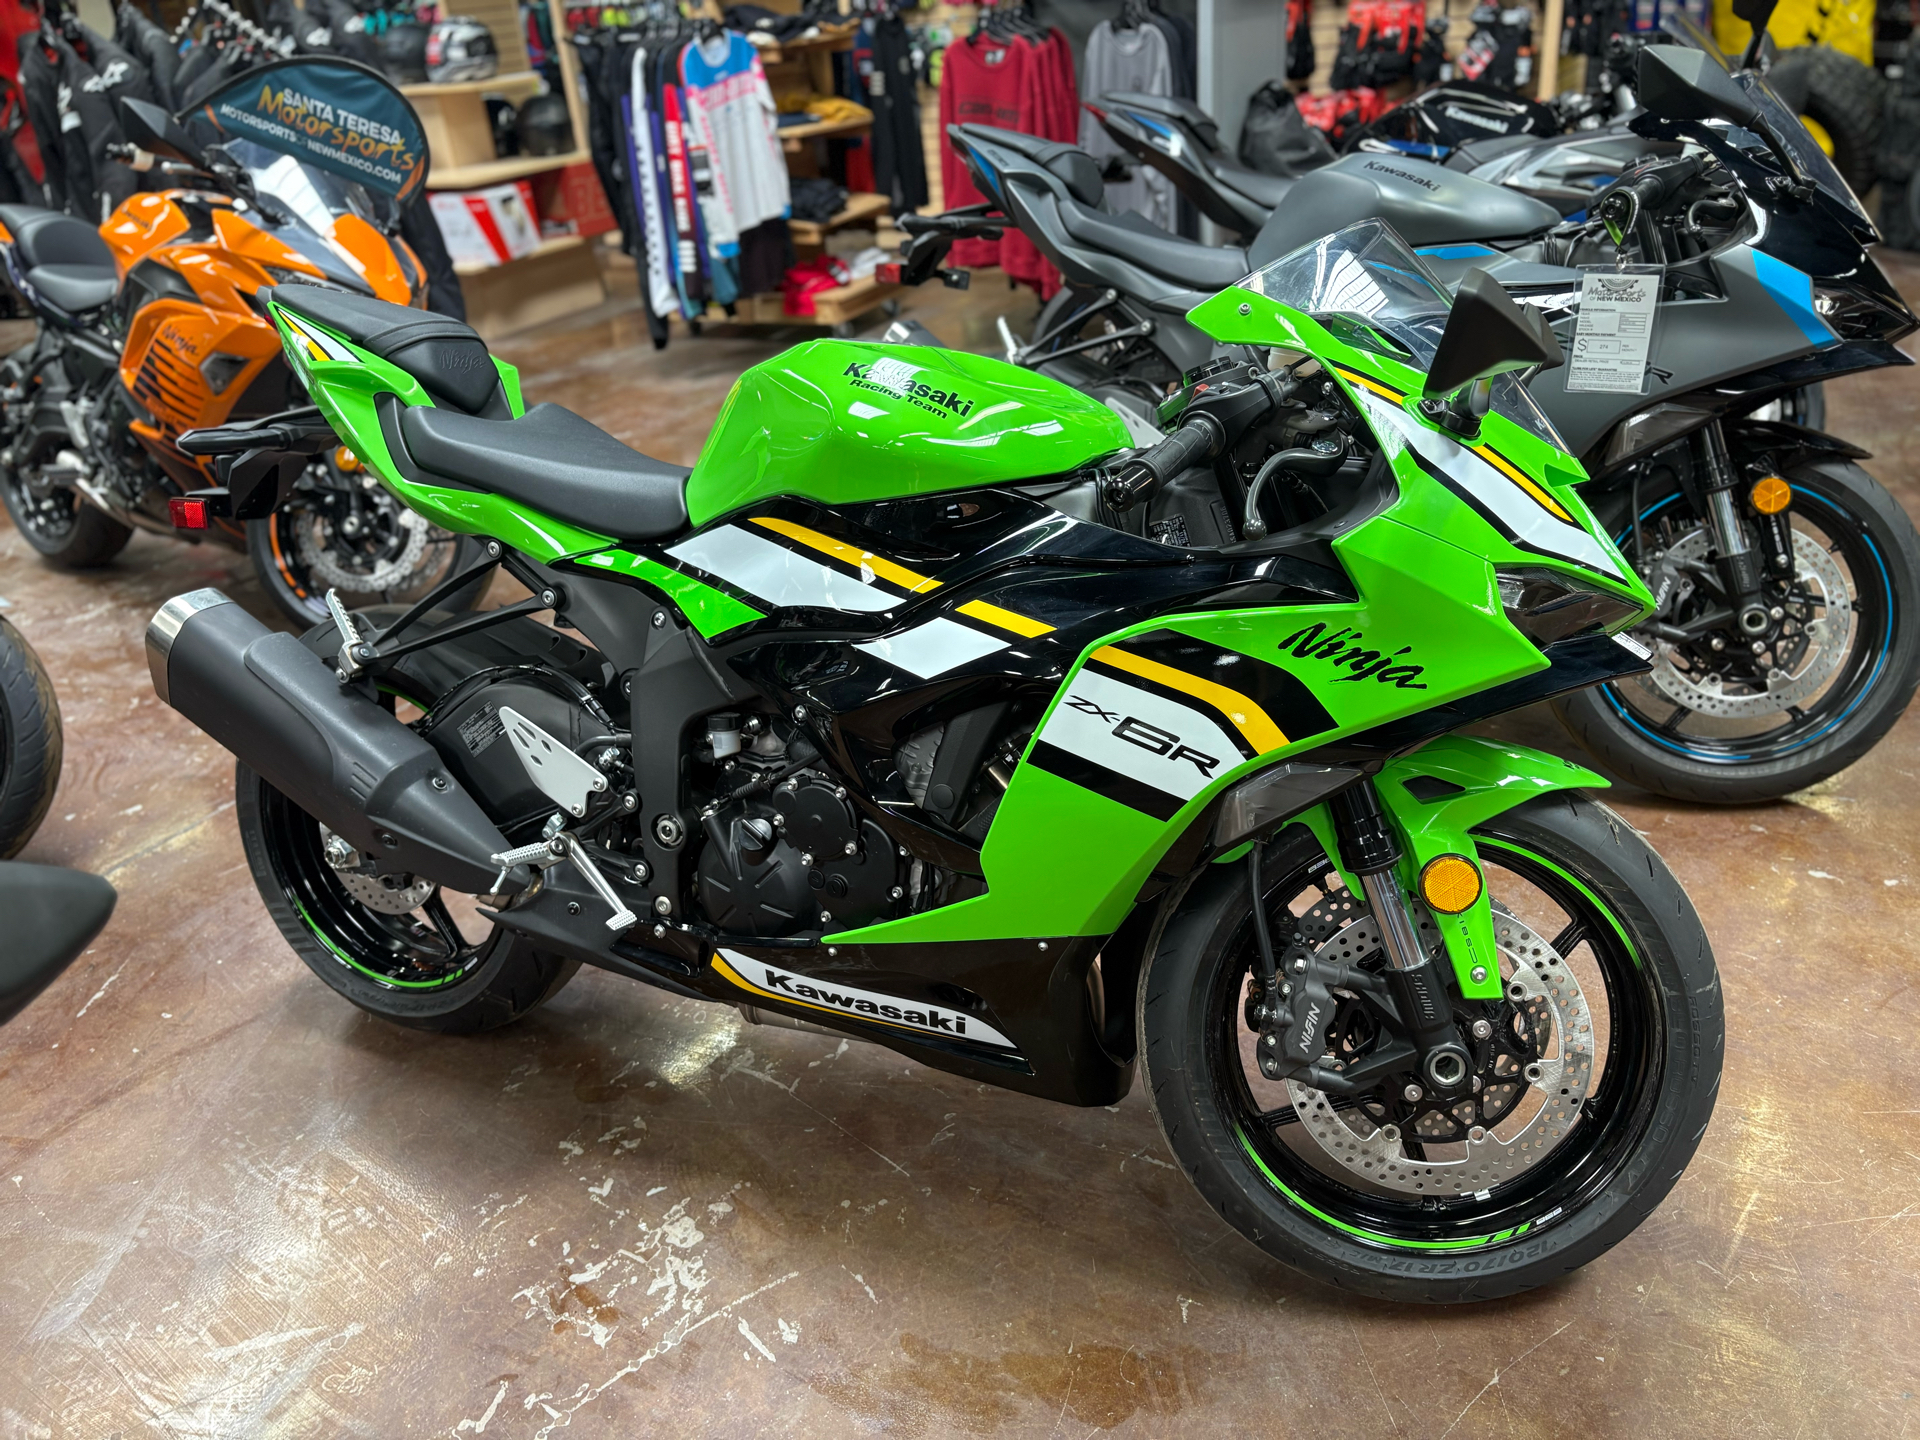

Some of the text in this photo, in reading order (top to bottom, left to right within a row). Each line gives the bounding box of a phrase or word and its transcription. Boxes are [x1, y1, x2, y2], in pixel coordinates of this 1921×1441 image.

[257, 85, 415, 170] Motorsports
[282, 88, 400, 144] SANTA TERESA
[1363, 160, 1442, 192] Kawasaki
[1587, 286, 1647, 299] Motorsports
[439, 349, 486, 374] Ninja
[1577, 338, 1587, 352] $
[849, 379, 948, 419] Racing Team
[1277, 622, 1428, 690] Ninja
[1063, 694, 1221, 780] ZX-6R
[765, 968, 966, 1035] Kawasaki
[1387, 1260, 1414, 1272] 17
[1417, 1261, 1453, 1275] ZR
[1462, 1239, 1550, 1275] 120/70
